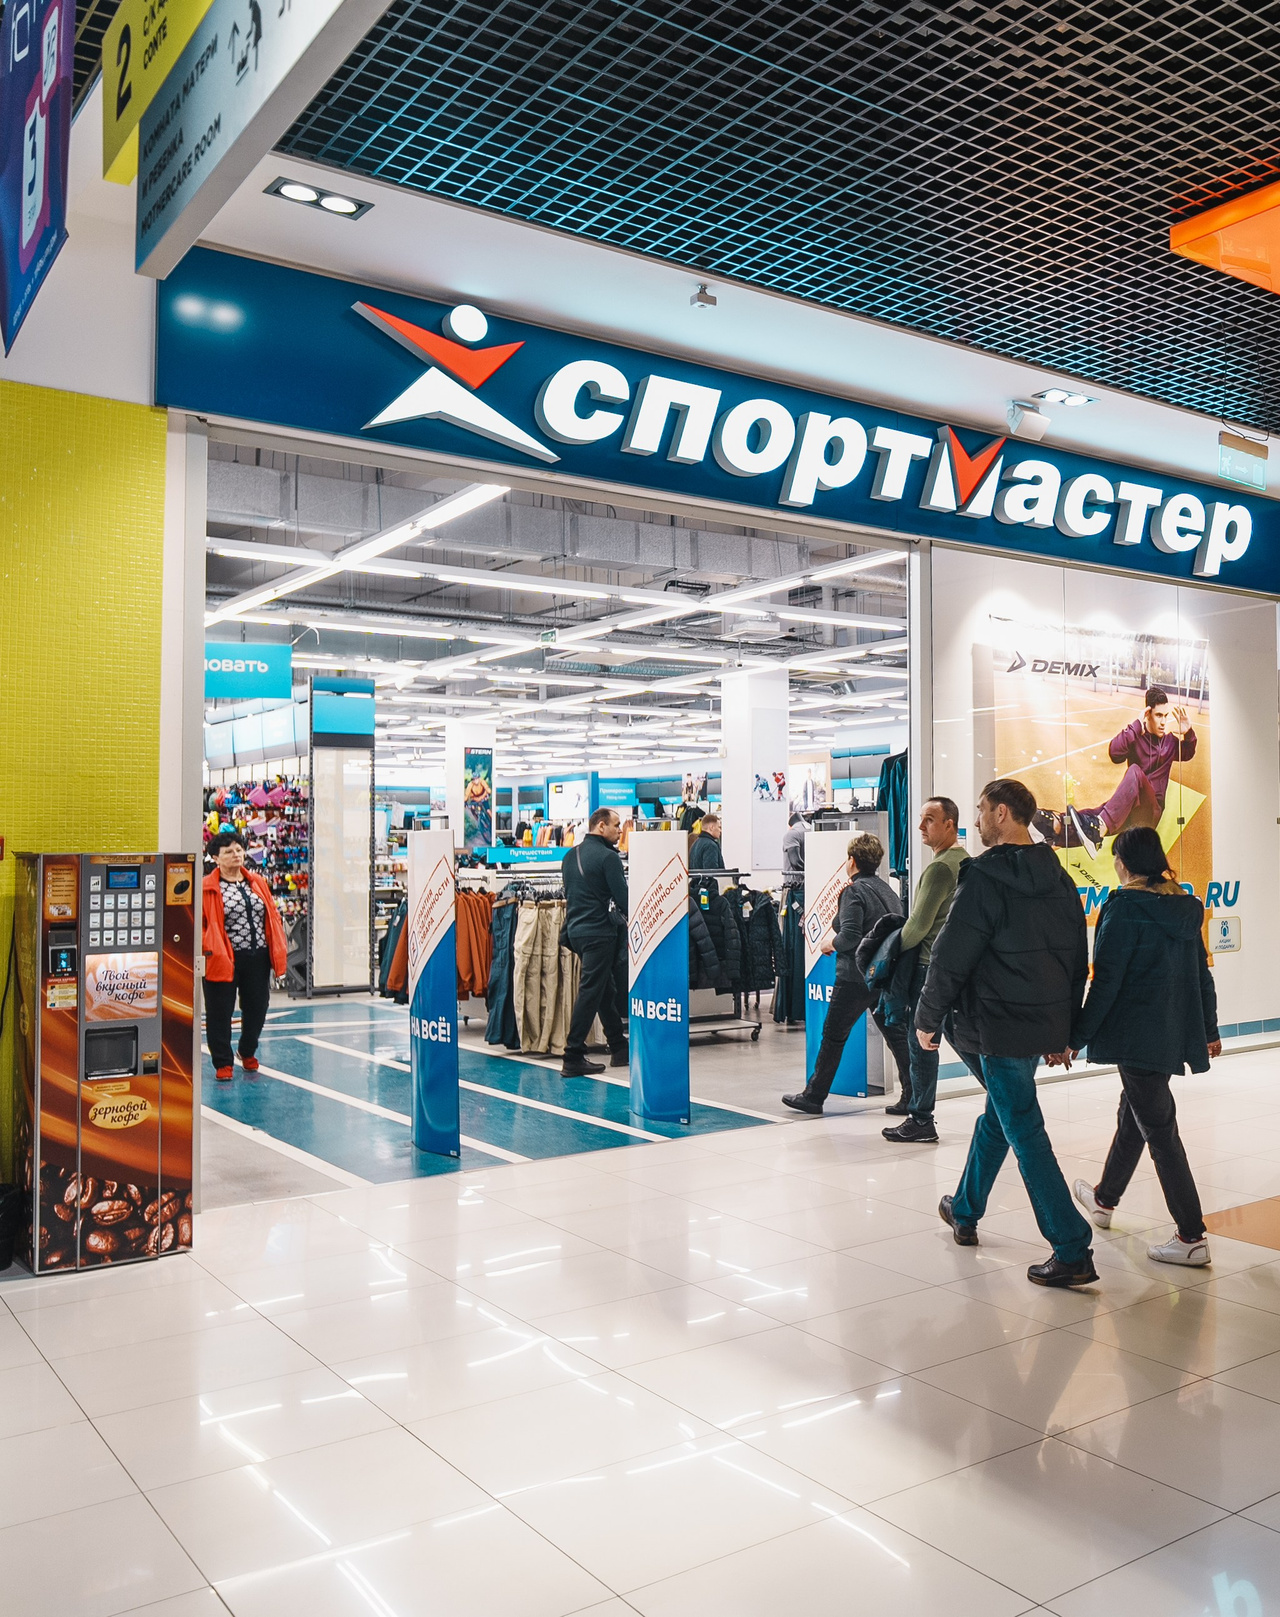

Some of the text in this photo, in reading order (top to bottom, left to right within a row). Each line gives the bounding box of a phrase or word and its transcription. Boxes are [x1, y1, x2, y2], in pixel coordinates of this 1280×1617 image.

[143, 15, 168, 70] CONTE
[116, 23, 132, 122] 2
[143, 33, 219, 162] КОМНАТА МАТЕРИ
[141, 112, 222, 239] MOTHERCARE ROOM
[1031, 659, 1101, 677] DEMIX
[510, 849, 553, 857] Путешествия
[1079, 869, 1101, 891] DEMI
[638, 883, 664, 921] ГАРАНТИЯ
[640, 873, 684, 930] ПОДЛИННОСТИ
[816, 878, 841, 914] ГАРАНТИЯ
[643, 908, 664, 937] ТОВАРА
[822, 904, 838, 927] ТОВАР
[419, 916, 435, 947] ТОВАРА
[95, 979, 148, 996] вкусный
[101, 970, 129, 981] Твой
[114, 991, 145, 1005] кофе
[631, 998, 682, 1023] НА ВСЁ!
[411, 1016, 451, 1043] НА ВСЁ!
[90, 1100, 148, 1121] зерновой
[110, 1112, 140, 1127] кофе
